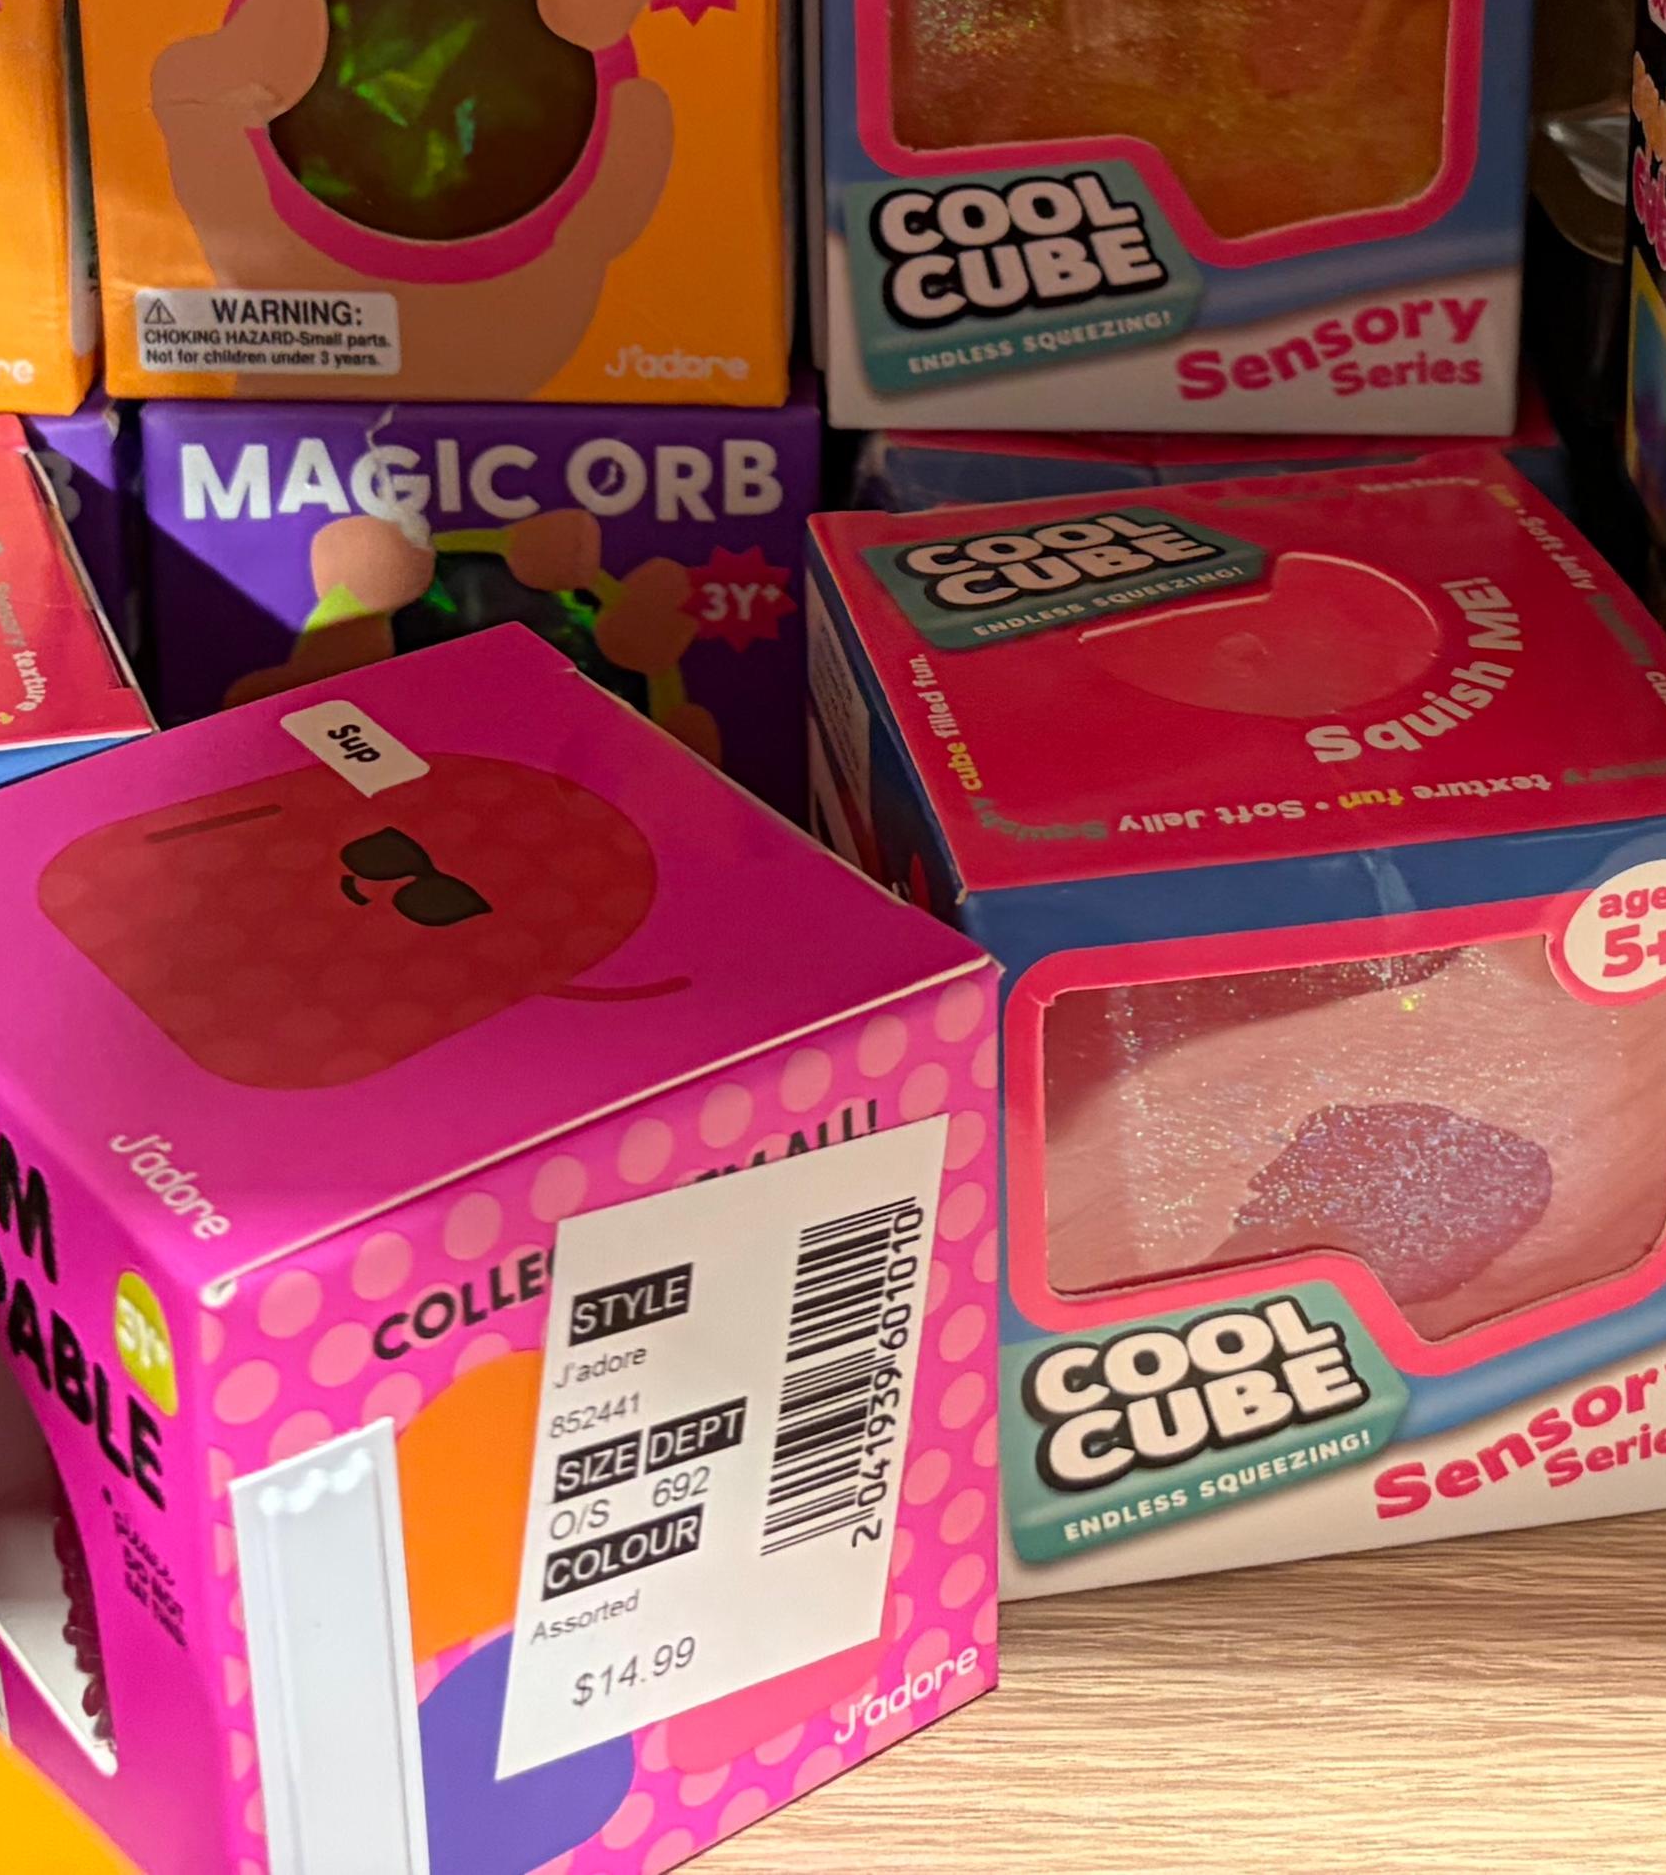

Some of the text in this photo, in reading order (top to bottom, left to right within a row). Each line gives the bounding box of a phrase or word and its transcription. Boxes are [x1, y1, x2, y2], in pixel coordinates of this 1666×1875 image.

[1176, 298, 1489, 402] Sensory
[1331, 353, 1482, 394] Series
[908, 510, 1172, 575] COOL
[935, 534, 1213, 608] CUBE
[973, 565, 1245, 637] ENDLESS SQUEEZING!
[1305, 577, 1524, 764] Squish ME!
[110, 1132, 230, 1241] J'adore
[573, 1275, 687, 1336] STYLE
[1034, 1296, 1337, 1412] COOL
[550, 1394, 640, 1439] 852441
[558, 1409, 744, 1491] SIZE DEPT
[1047, 1349, 1361, 1480] CUBE
[551, 1466, 710, 1541] O/S 692
[1064, 1431, 1370, 1541] ENDLESS SQUEEZING!
[547, 1517, 697, 1589] COLOUR
[530, 1590, 639, 1644] Assorted
[571, 1637, 696, 1708] $14.99
[835, 1646, 977, 1745] J'adore
